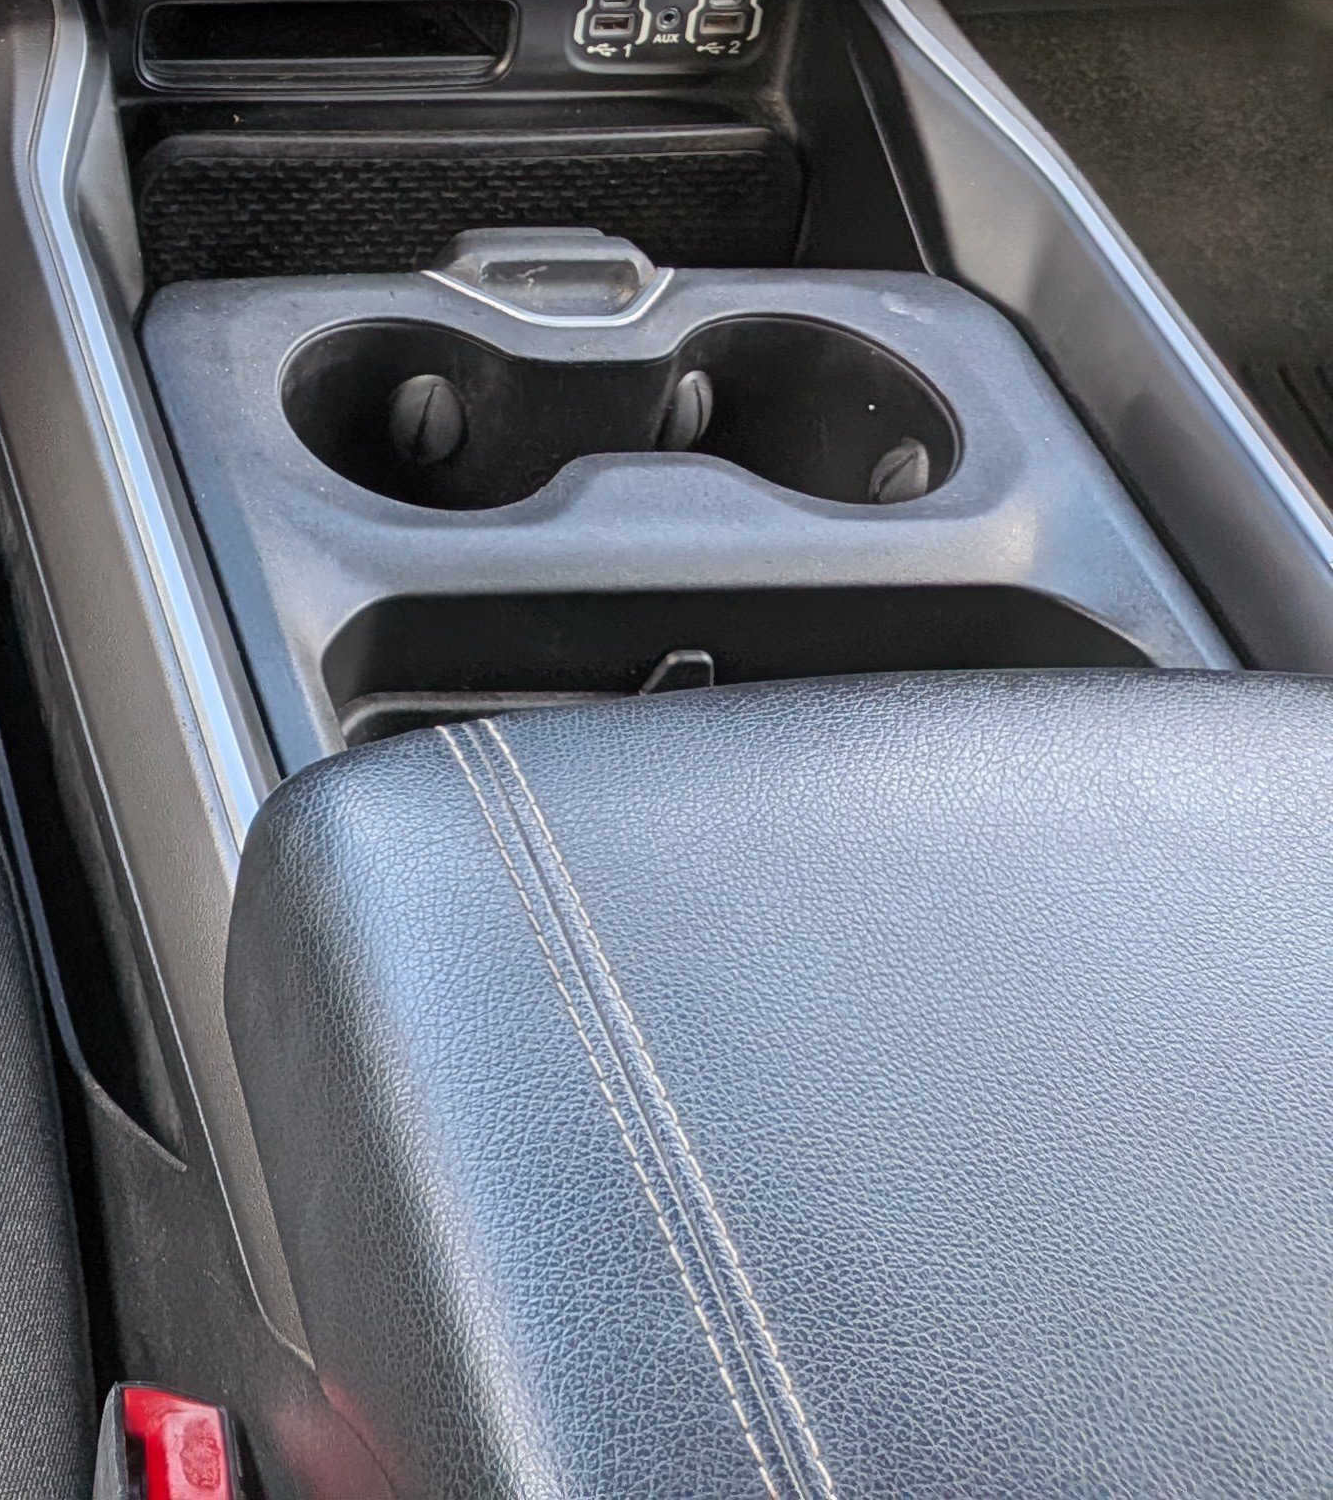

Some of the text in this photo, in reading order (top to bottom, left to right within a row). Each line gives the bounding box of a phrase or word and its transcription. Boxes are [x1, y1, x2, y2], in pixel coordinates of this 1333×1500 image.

[653, 33, 680, 44] AUX
[623, 44, 632, 58] 1
[728, 41, 740, 55] 2
